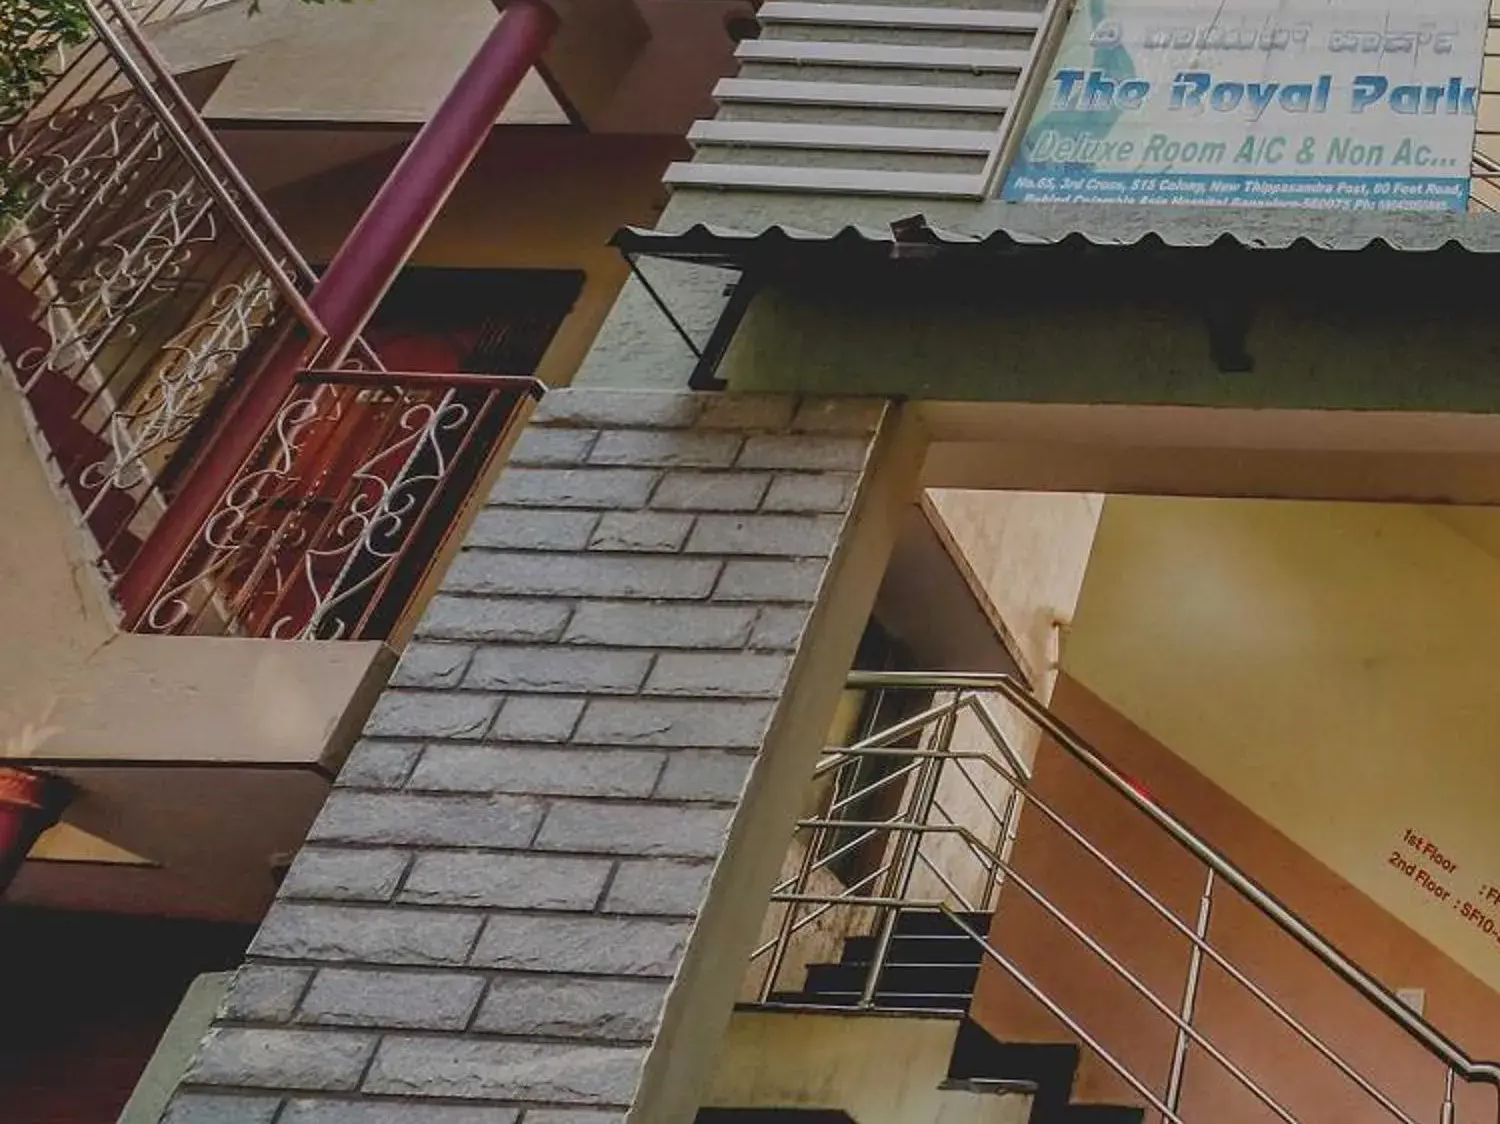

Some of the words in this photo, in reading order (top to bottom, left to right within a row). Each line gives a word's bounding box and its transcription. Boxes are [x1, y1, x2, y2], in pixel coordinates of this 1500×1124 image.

[1052, 69, 1151, 111] The
[1168, 72, 1332, 122] Royal
[1351, 75, 1476, 115] Park
[1032, 129, 1135, 162] Deluxe
[1143, 133, 1227, 164] Room
[1233, 135, 1287, 165] A/C
[1295, 135, 1316, 165] &
[1326, 136, 1385, 166] Non
[1403, 828, 1424, 851] 1st
[1422, 842, 1457, 874] Floor
[1388, 851, 1417, 877] 2nd
[1414, 869, 1450, 901] Floor
